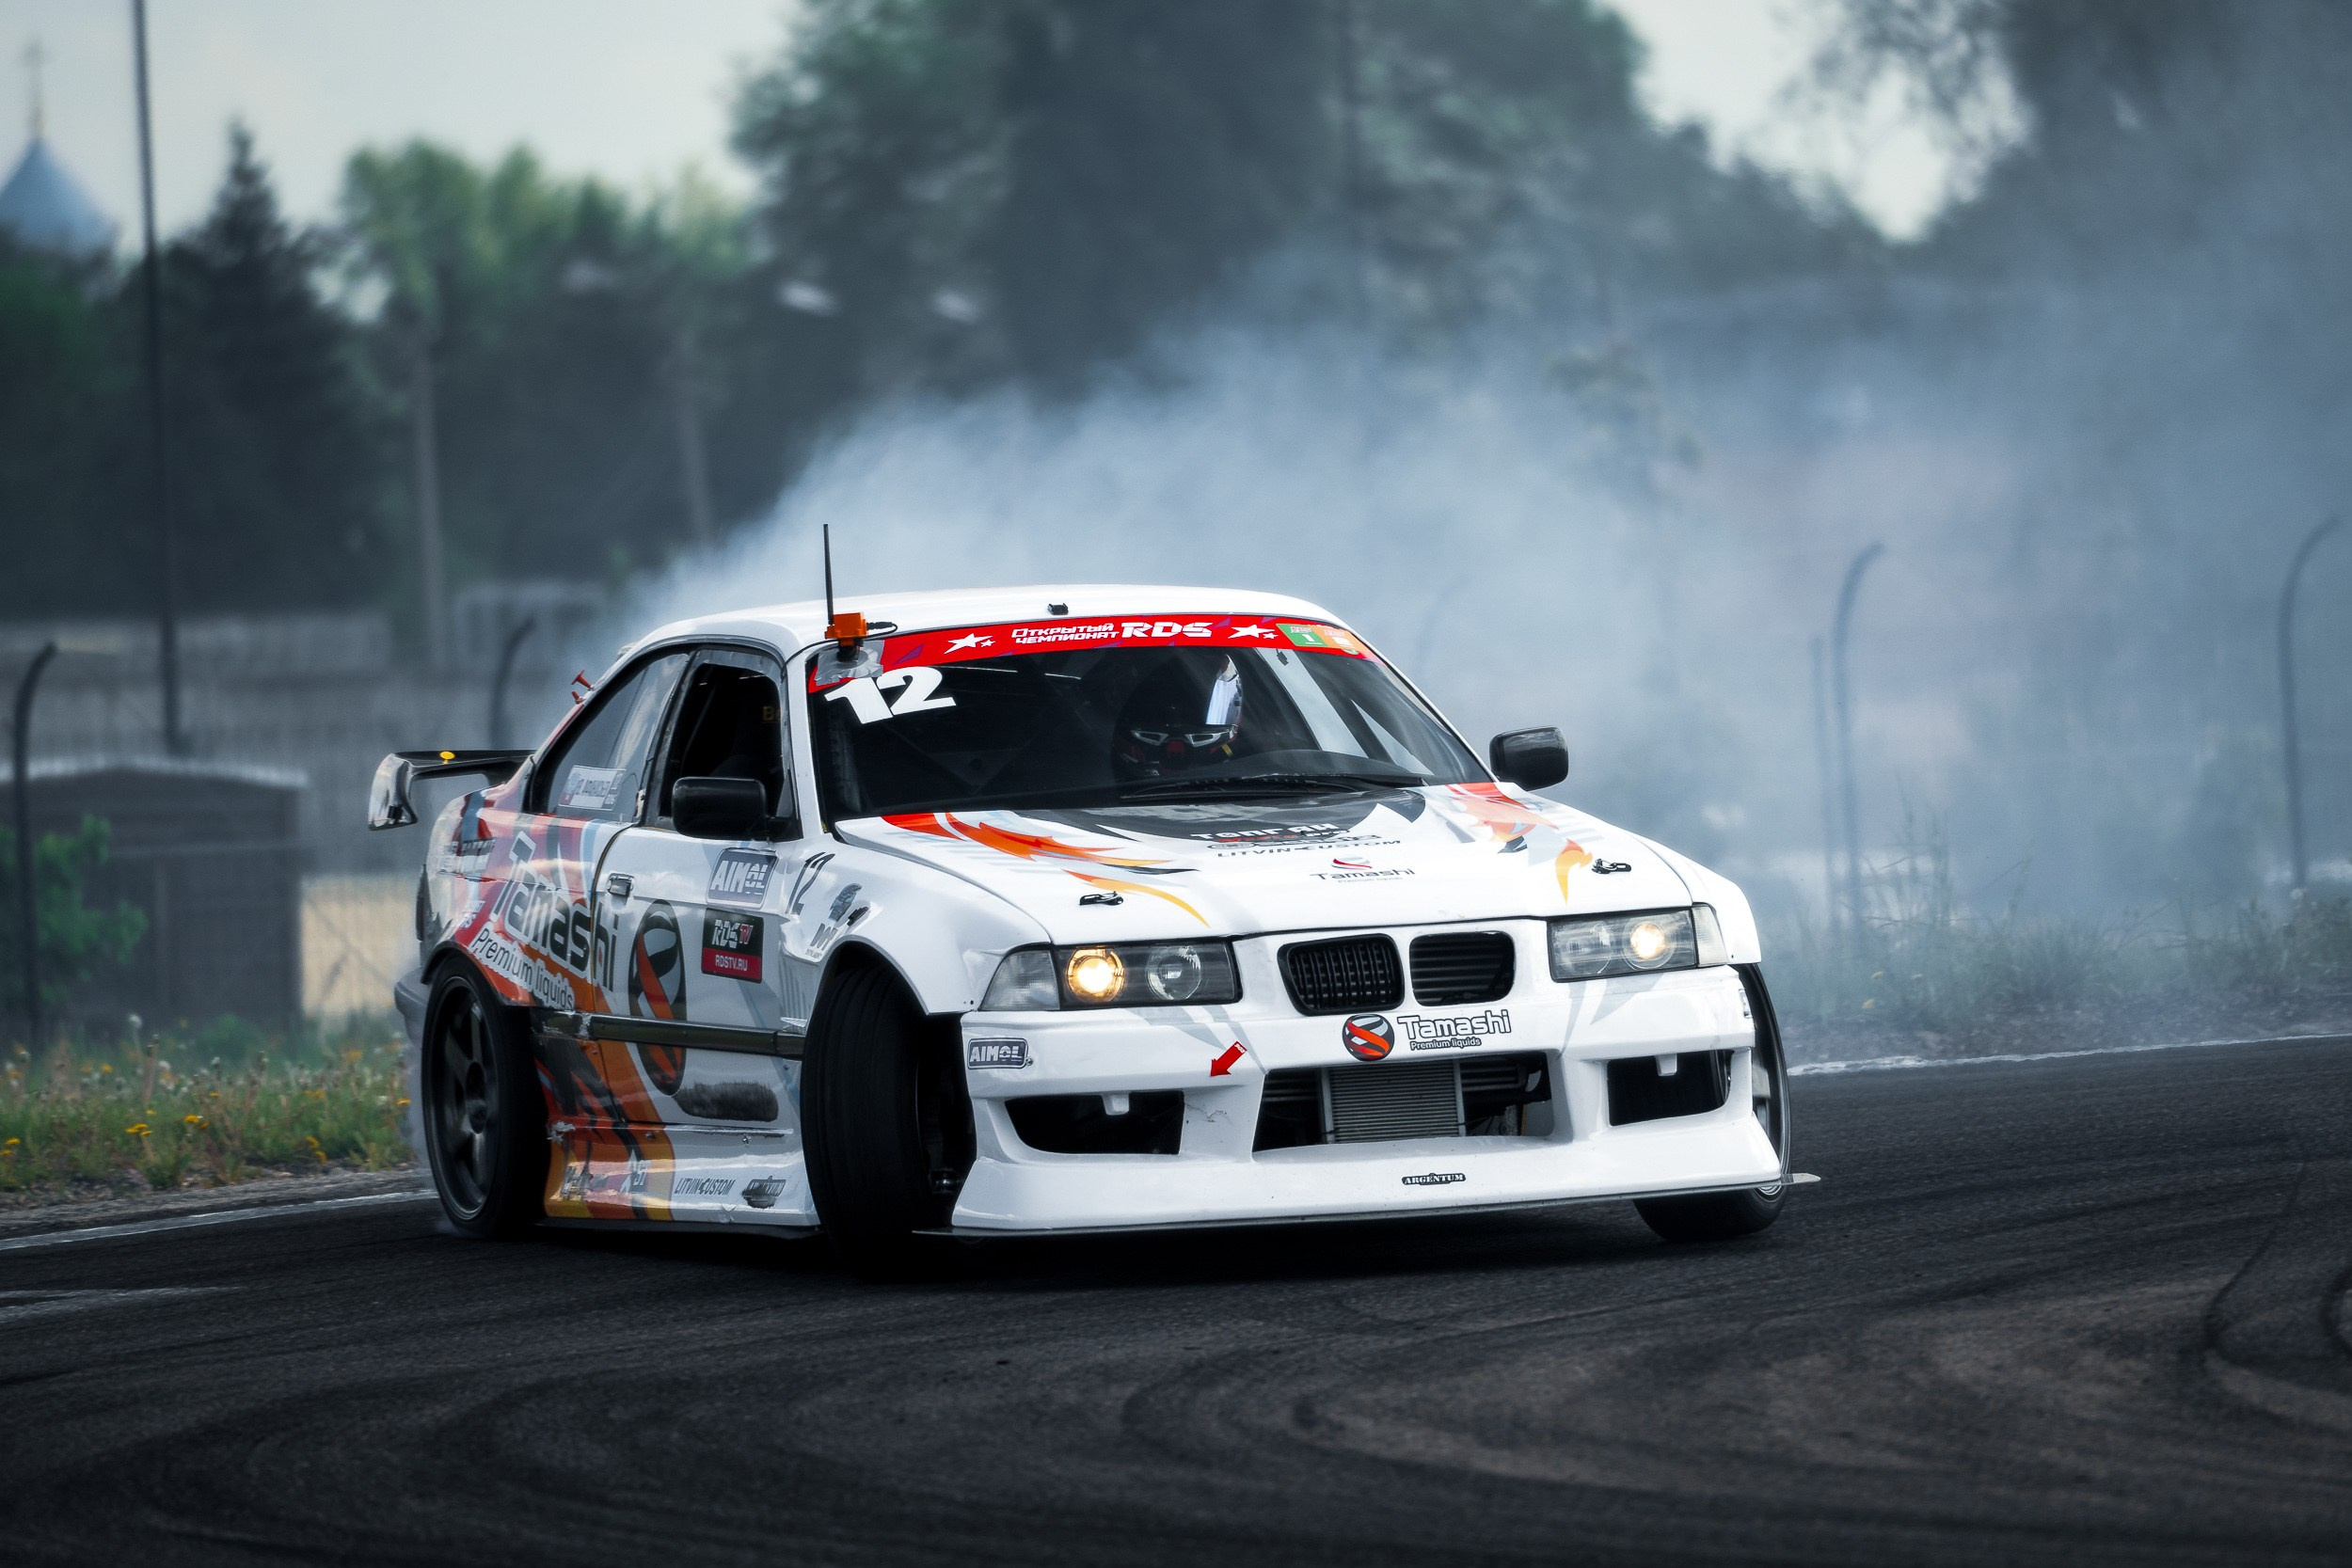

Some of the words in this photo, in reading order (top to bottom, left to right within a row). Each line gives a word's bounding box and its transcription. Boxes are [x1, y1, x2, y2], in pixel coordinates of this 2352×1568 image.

[1015, 631, 1120, 644] ЧЕМПИОНАТ
[1121, 622, 1214, 638] RDS
[824, 666, 956, 724] 12
[710, 860, 769, 895] AIMOL
[785, 851, 835, 914] 12
[1310, 868, 1416, 880] Tamashi
[490, 832, 620, 992] Tamashi
[471, 928, 533, 986] Premium
[535, 964, 574, 1010] liquids
[715, 954, 748, 972] RDSTV.RU
[1397, 1009, 1512, 1039] Tamashi
[1410, 1038, 1451, 1051] Premium
[1452, 1037, 1482, 1049] liquids
[969, 1045, 1023, 1062] AIMOL
[1404, 1174, 1464, 1184] ARGENTUM
